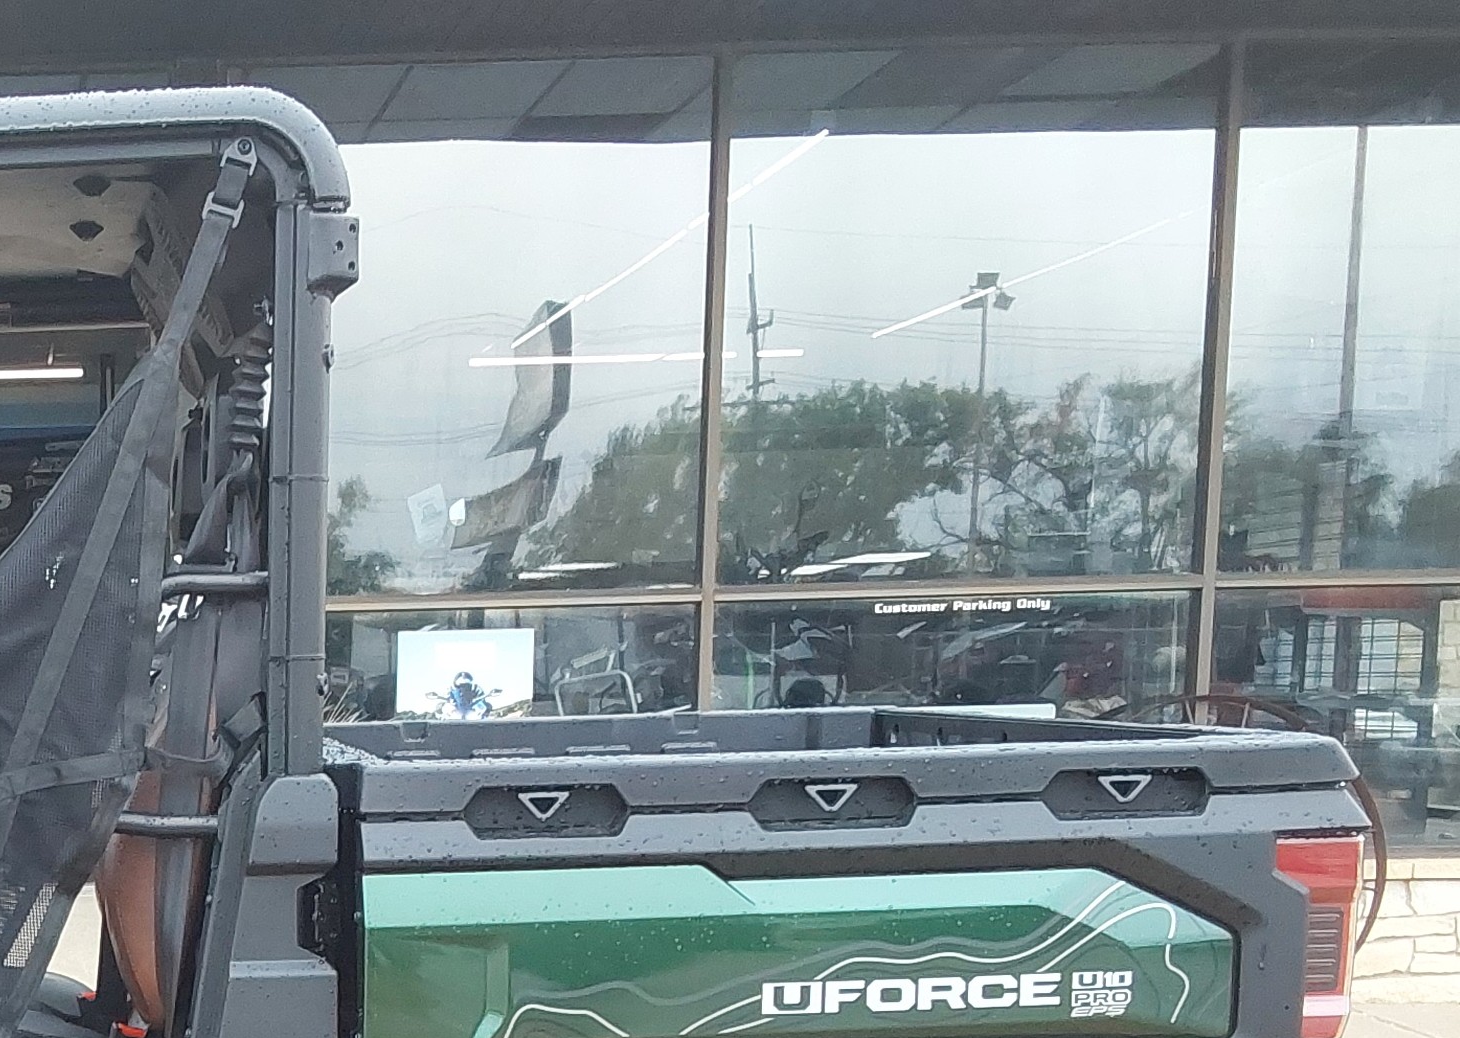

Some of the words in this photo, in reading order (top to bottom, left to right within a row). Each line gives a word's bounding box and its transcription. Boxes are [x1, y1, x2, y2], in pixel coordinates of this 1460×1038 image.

[874, 603, 947, 614] Customer
[952, 600, 1012, 612] Parking
[1016, 598, 1051, 611] Only
[1071, 971, 1133, 989] U10
[1071, 989, 1133, 1005] PRO
[1070, 1004, 1128, 1018] EPS
